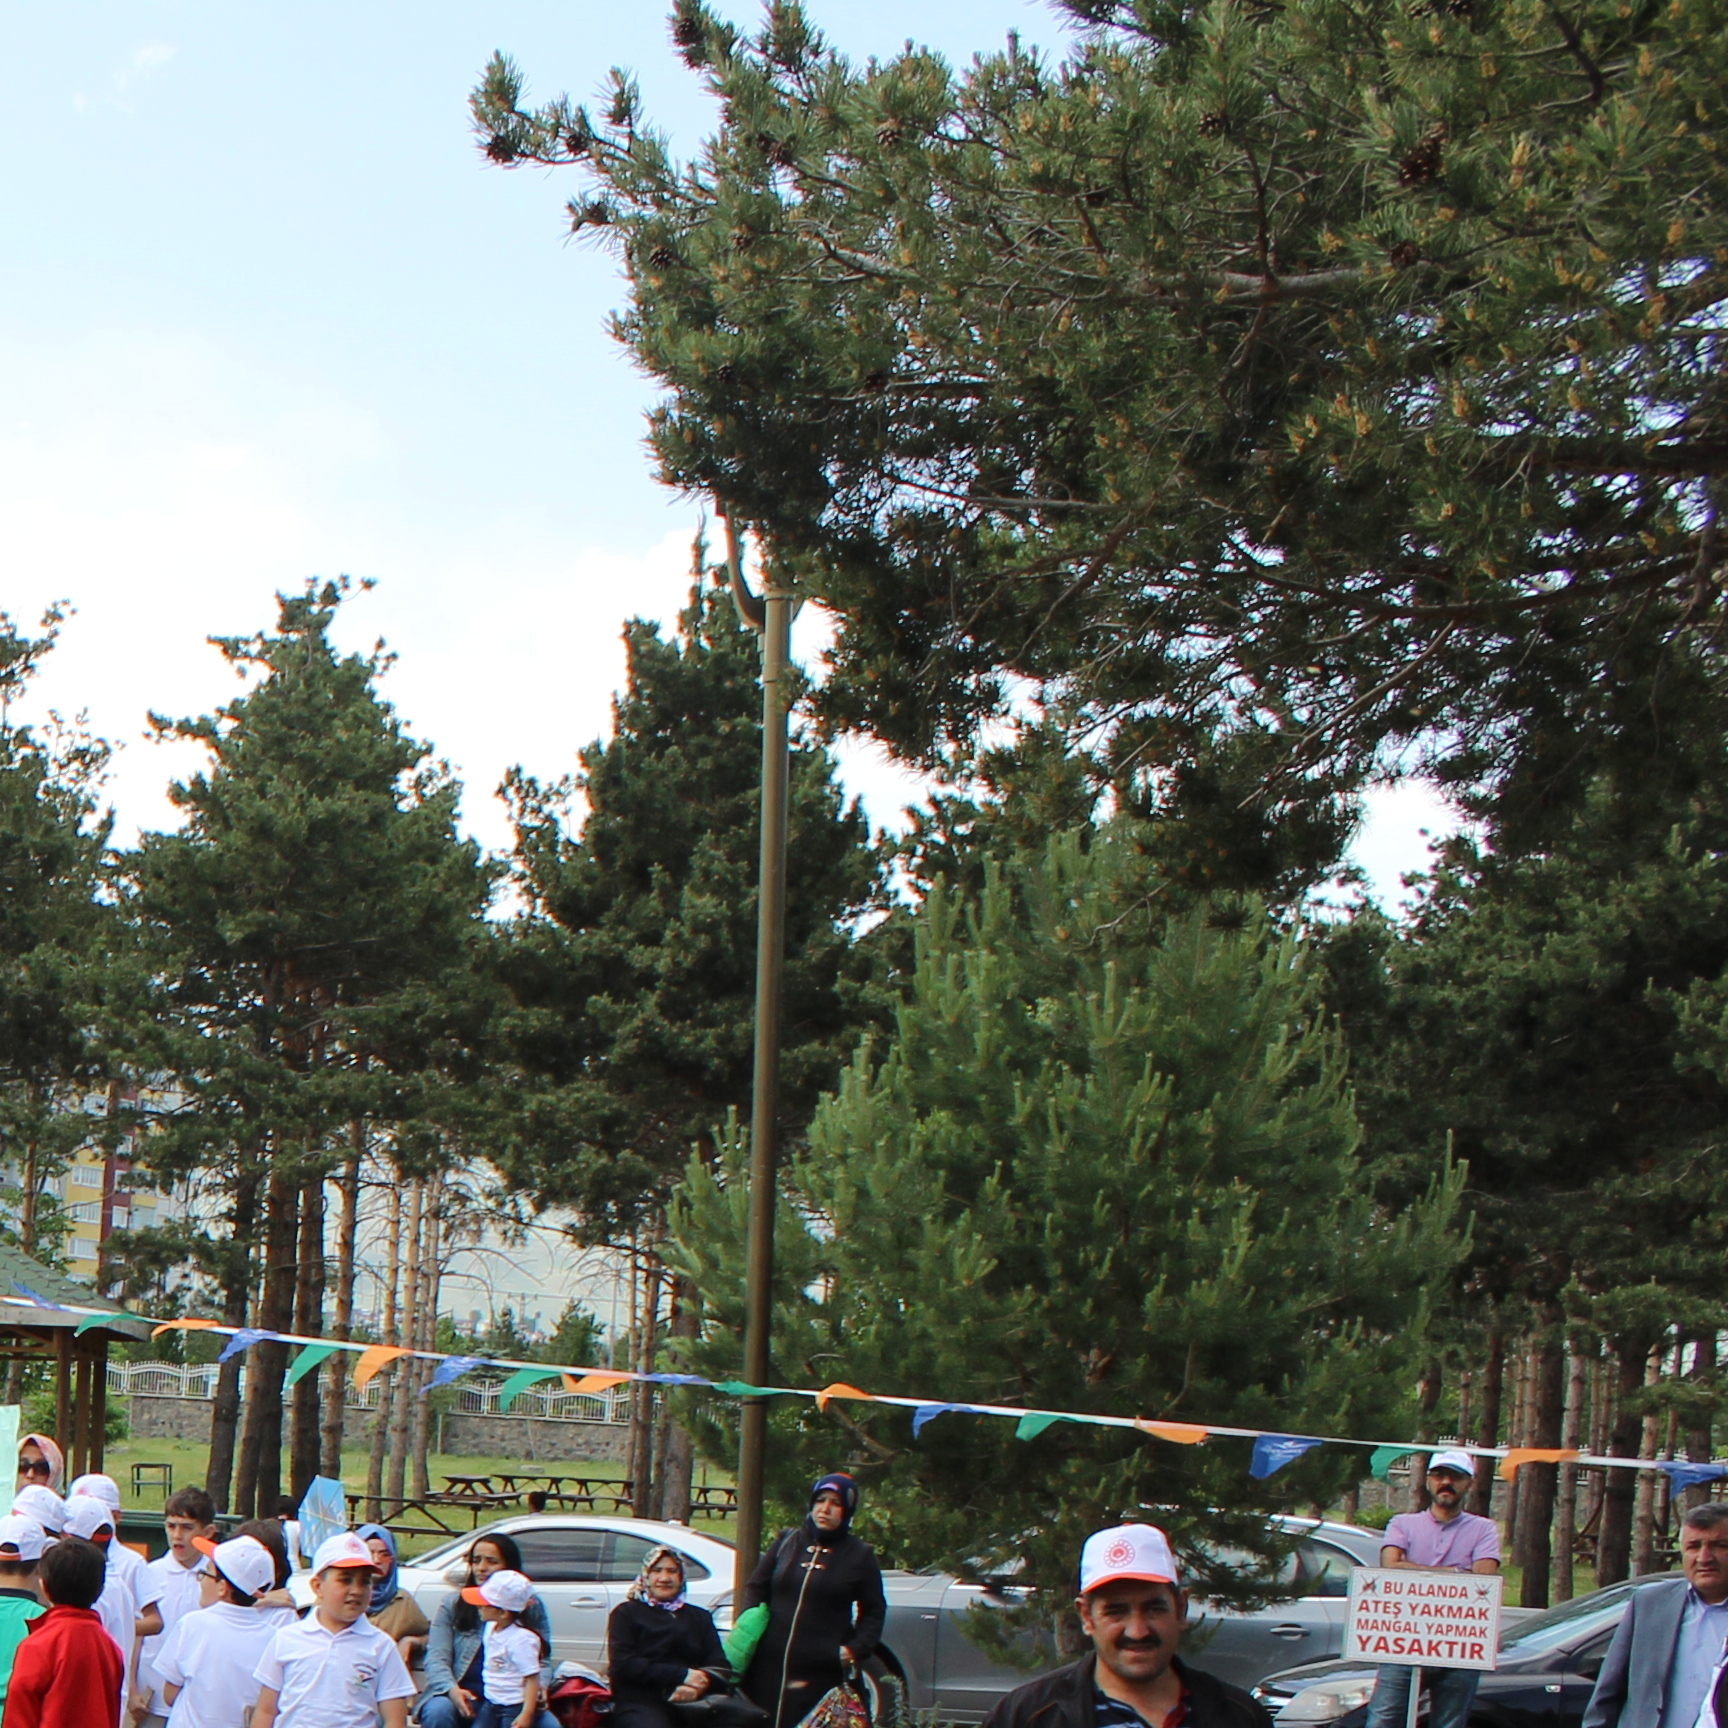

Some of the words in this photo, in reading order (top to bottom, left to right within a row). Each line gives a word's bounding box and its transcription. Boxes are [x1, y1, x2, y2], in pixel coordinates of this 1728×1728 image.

[1383, 1581, 1404, 1595] BU
[1407, 1583, 1469, 1599] ALANDA
[1357, 1599, 1403, 1618] ATEŞ
[1408, 1602, 1490, 1621] YAKMAK
[1356, 1618, 1421, 1634] MANGAL
[1425, 1622, 1488, 1638] YAPMAK
[1356, 1634, 1485, 1660] YASAKTIR
